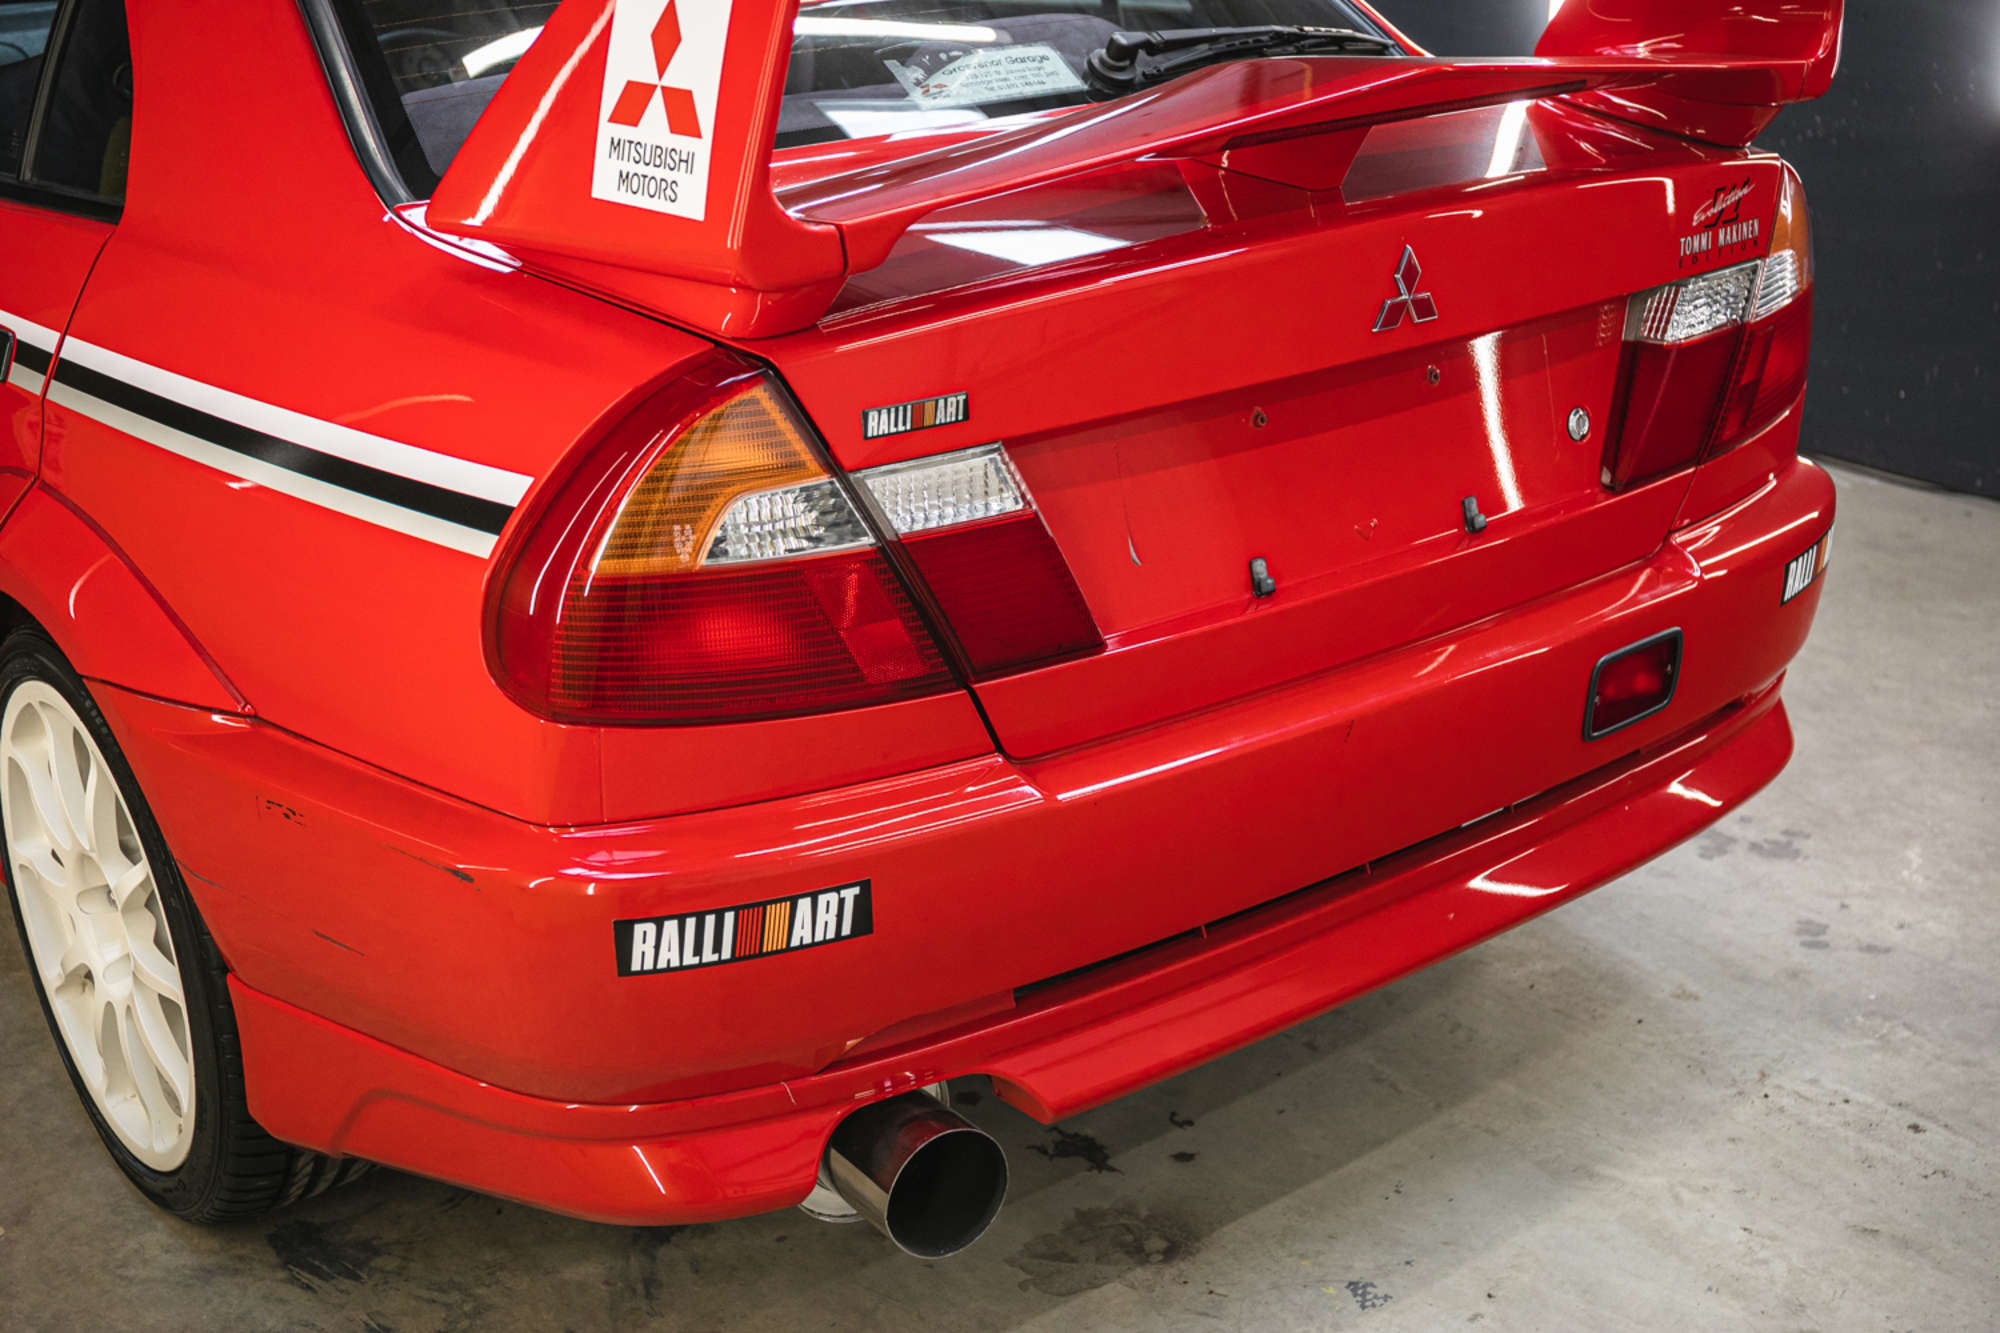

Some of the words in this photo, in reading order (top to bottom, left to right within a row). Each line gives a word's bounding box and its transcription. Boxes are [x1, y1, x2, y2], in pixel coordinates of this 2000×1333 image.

[1004, 53, 1050, 66] Garage
[608, 136, 695, 175] MITSUBISHI
[617, 169, 679, 204] MOTORS
[1679, 230, 1712, 257] TOMMI
[1718, 217, 1759, 247] MAKINEN
